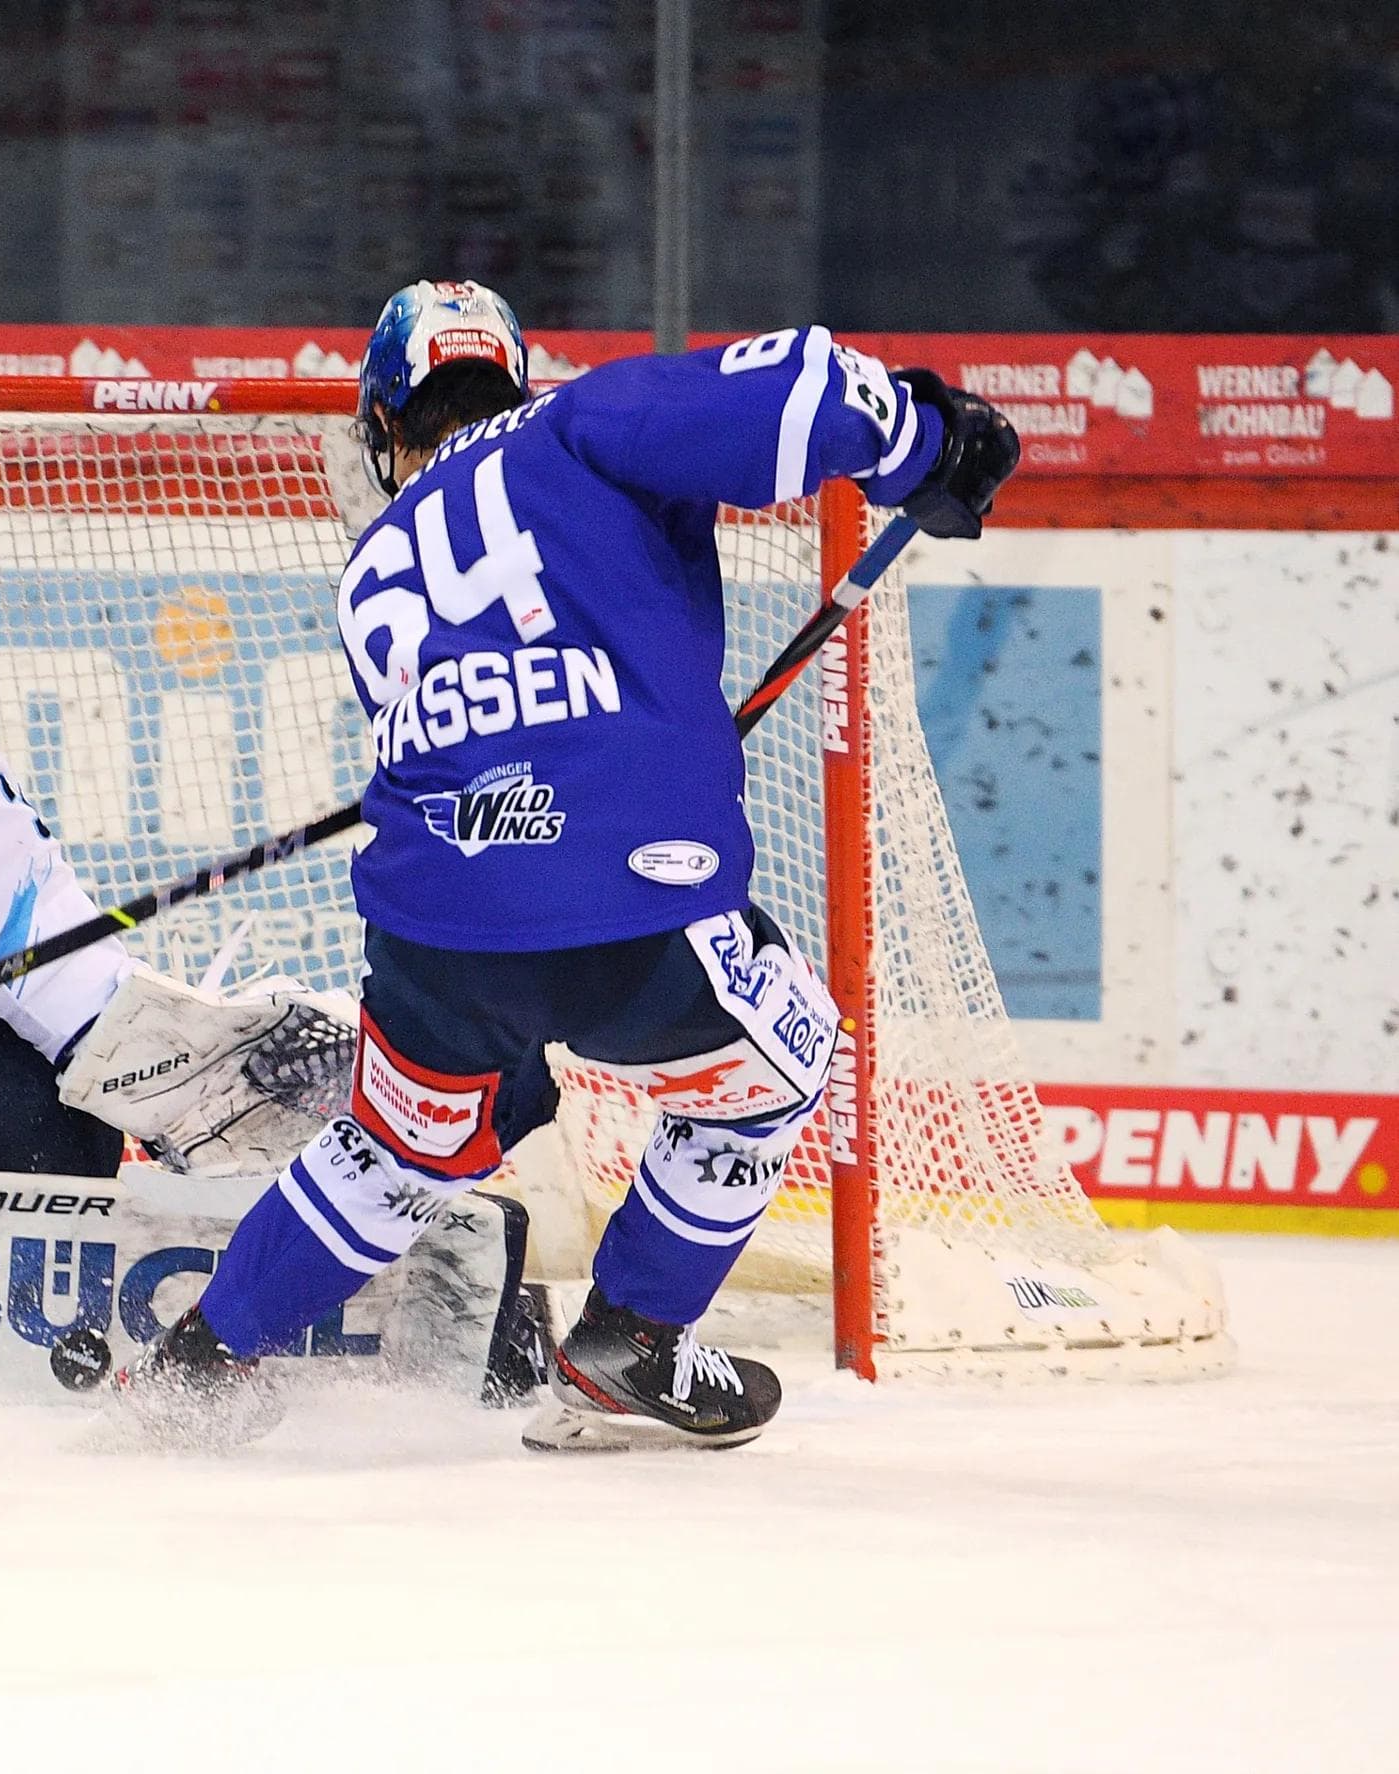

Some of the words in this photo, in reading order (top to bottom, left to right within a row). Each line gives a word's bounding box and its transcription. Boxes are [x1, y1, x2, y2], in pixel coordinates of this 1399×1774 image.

[961, 364, 1060, 398] WERNER
[1197, 364, 1299, 398] WERNER
[1199, 403, 1325, 438] WOHNBAU
[337, 447, 557, 706] 64
